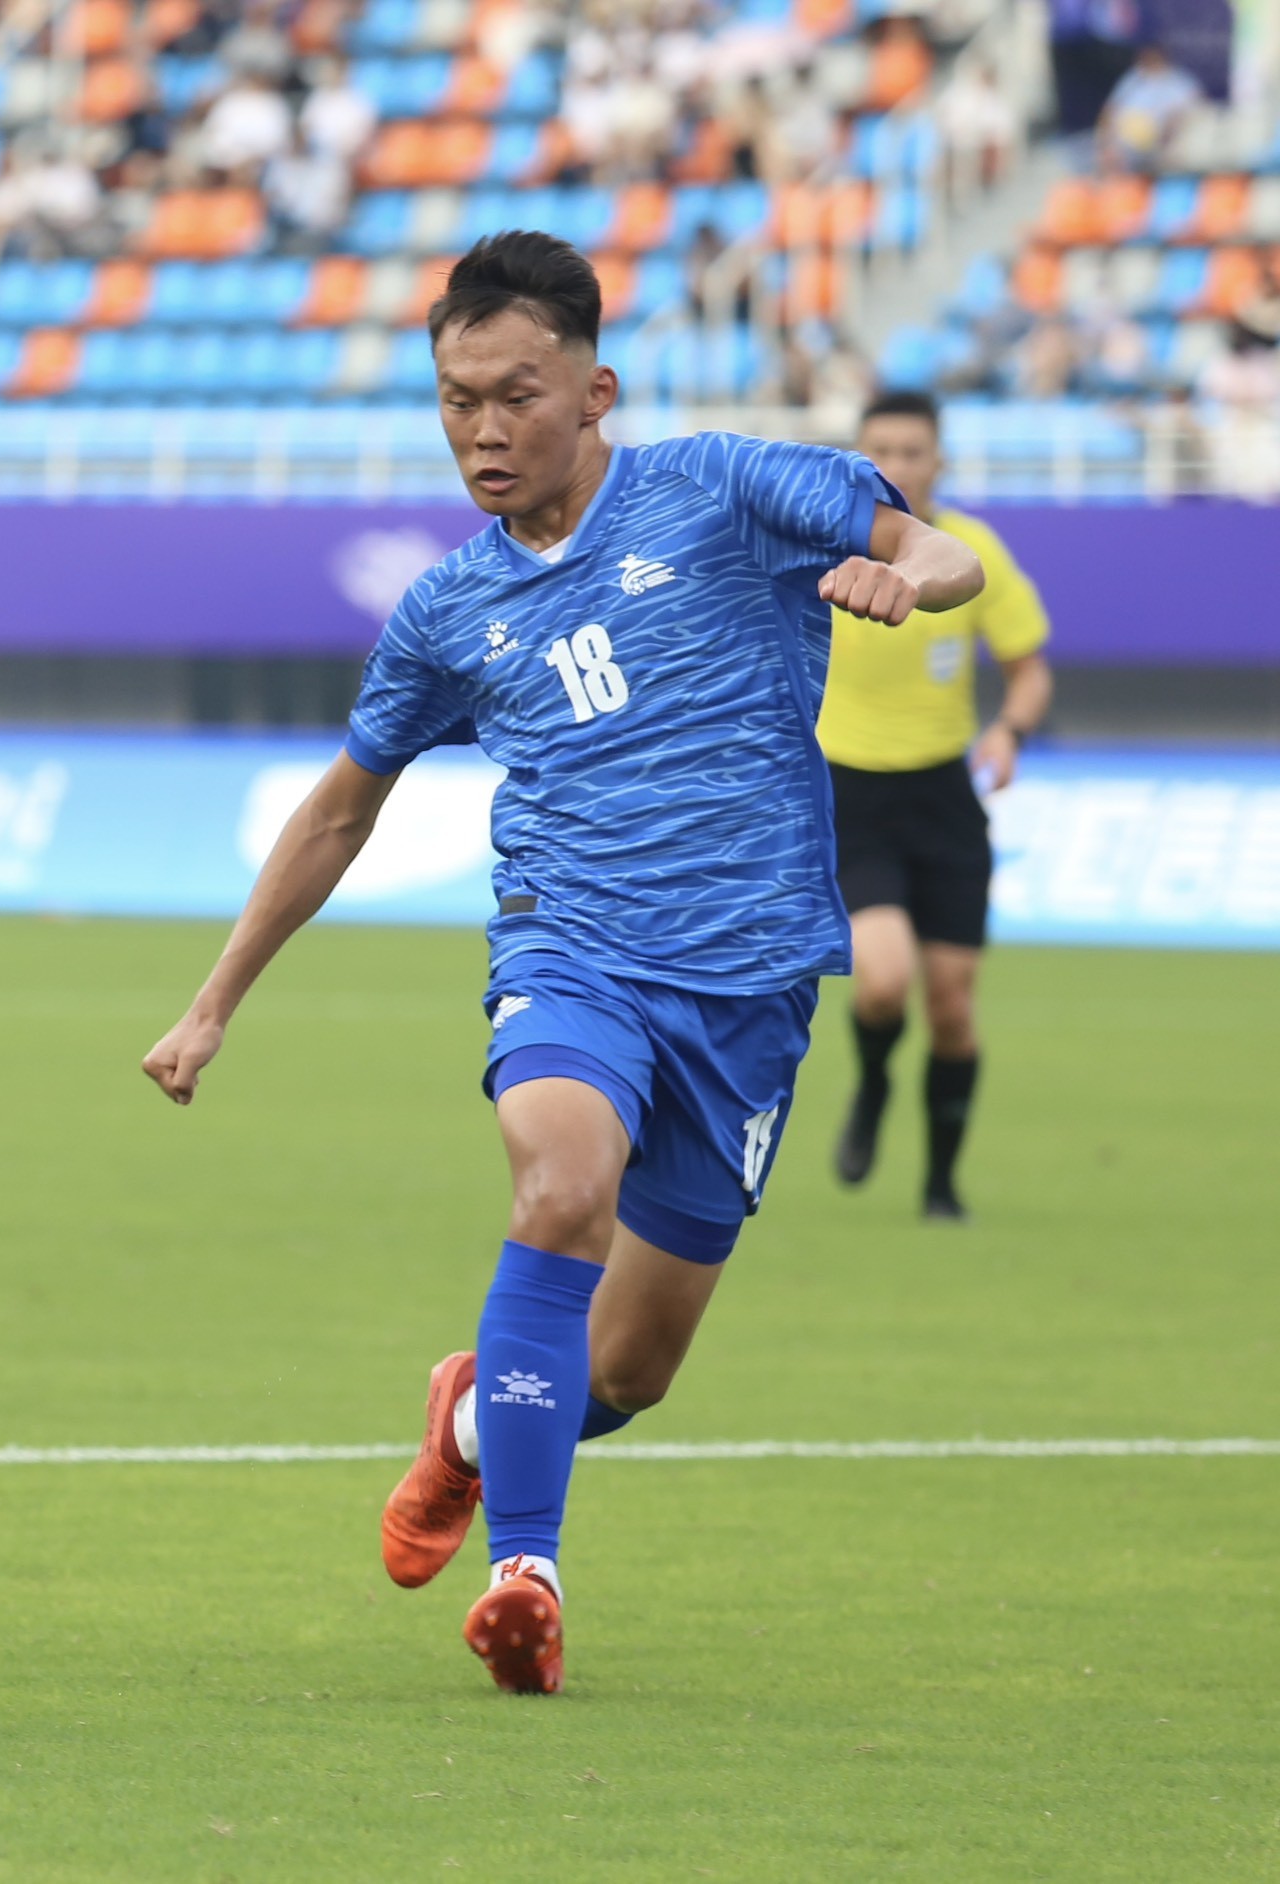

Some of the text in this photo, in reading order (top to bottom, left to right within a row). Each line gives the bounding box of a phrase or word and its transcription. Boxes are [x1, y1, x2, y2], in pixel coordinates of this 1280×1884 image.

[482, 638, 520, 664] KELME
[544, 623, 629, 723] 18
[489, 1392, 557, 1410] KELME
